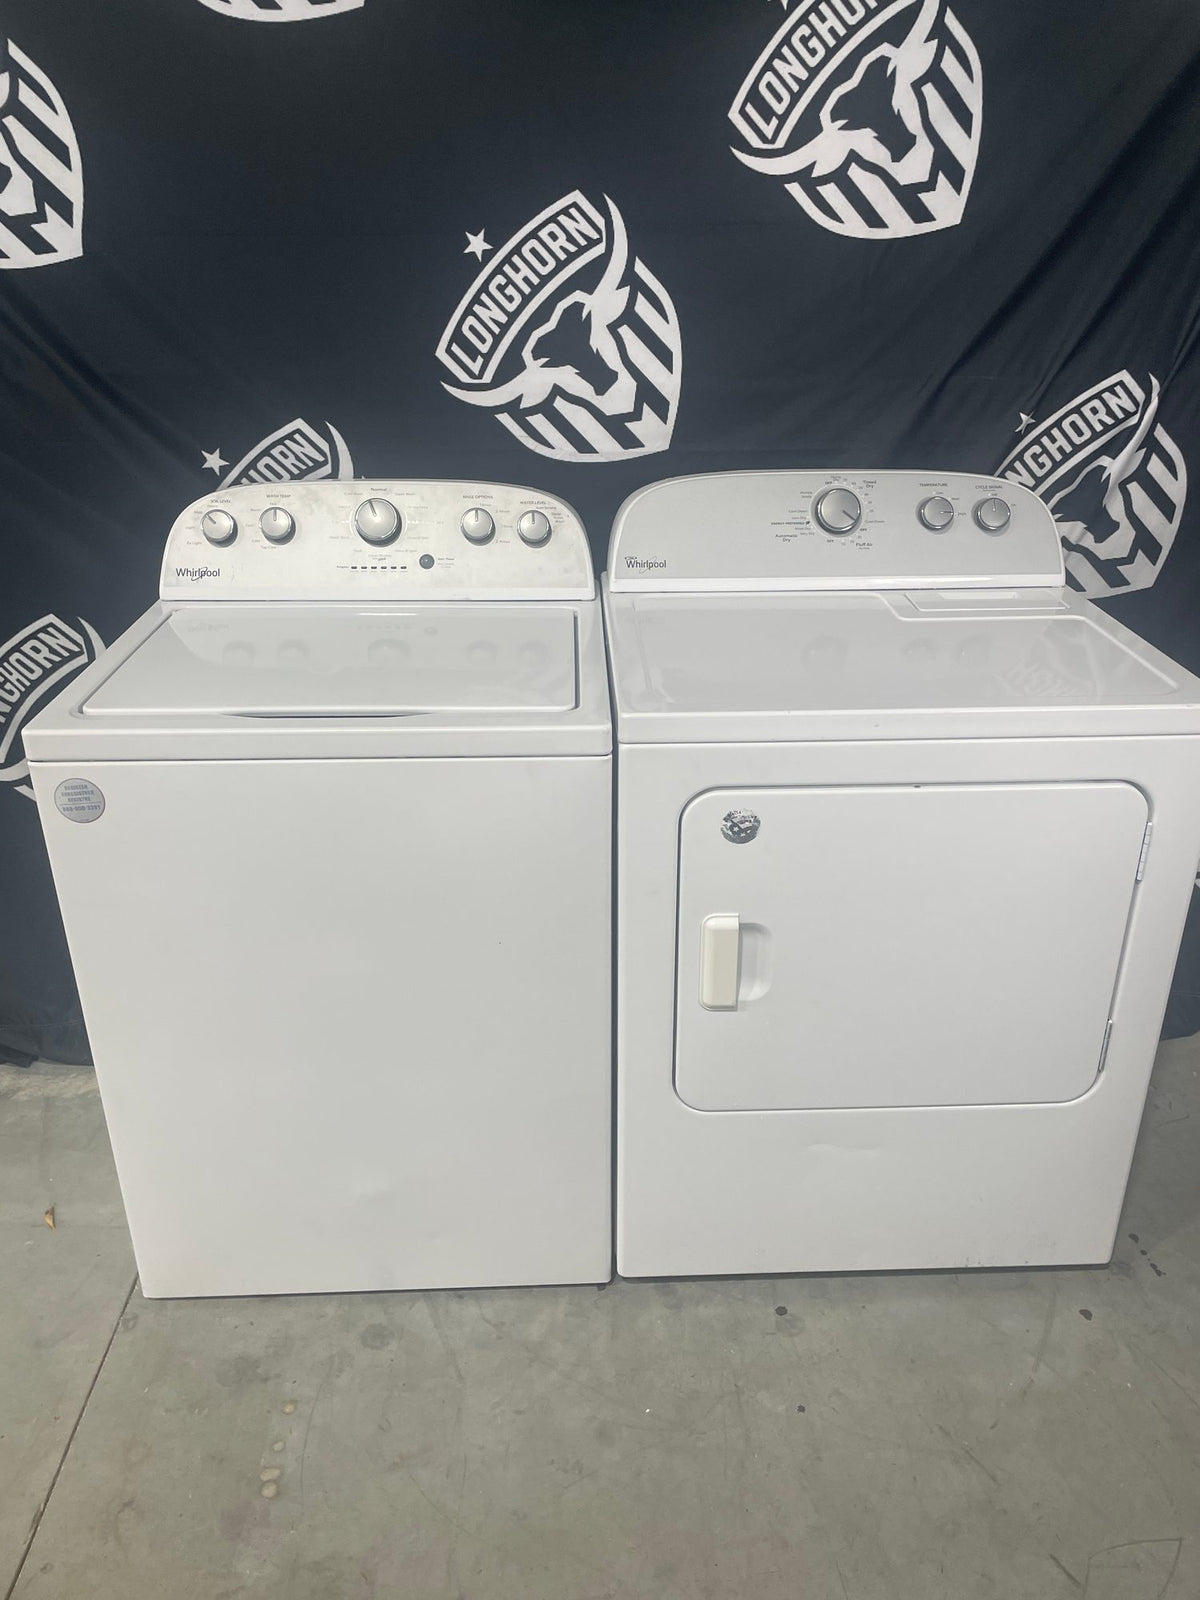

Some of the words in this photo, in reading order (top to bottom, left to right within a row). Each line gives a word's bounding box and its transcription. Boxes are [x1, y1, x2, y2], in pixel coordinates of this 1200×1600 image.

[450, 207, 600, 377] LONGHORN
[626, 559, 667, 571] Whirlpool
[176, 567, 220, 579] Whirlpool
